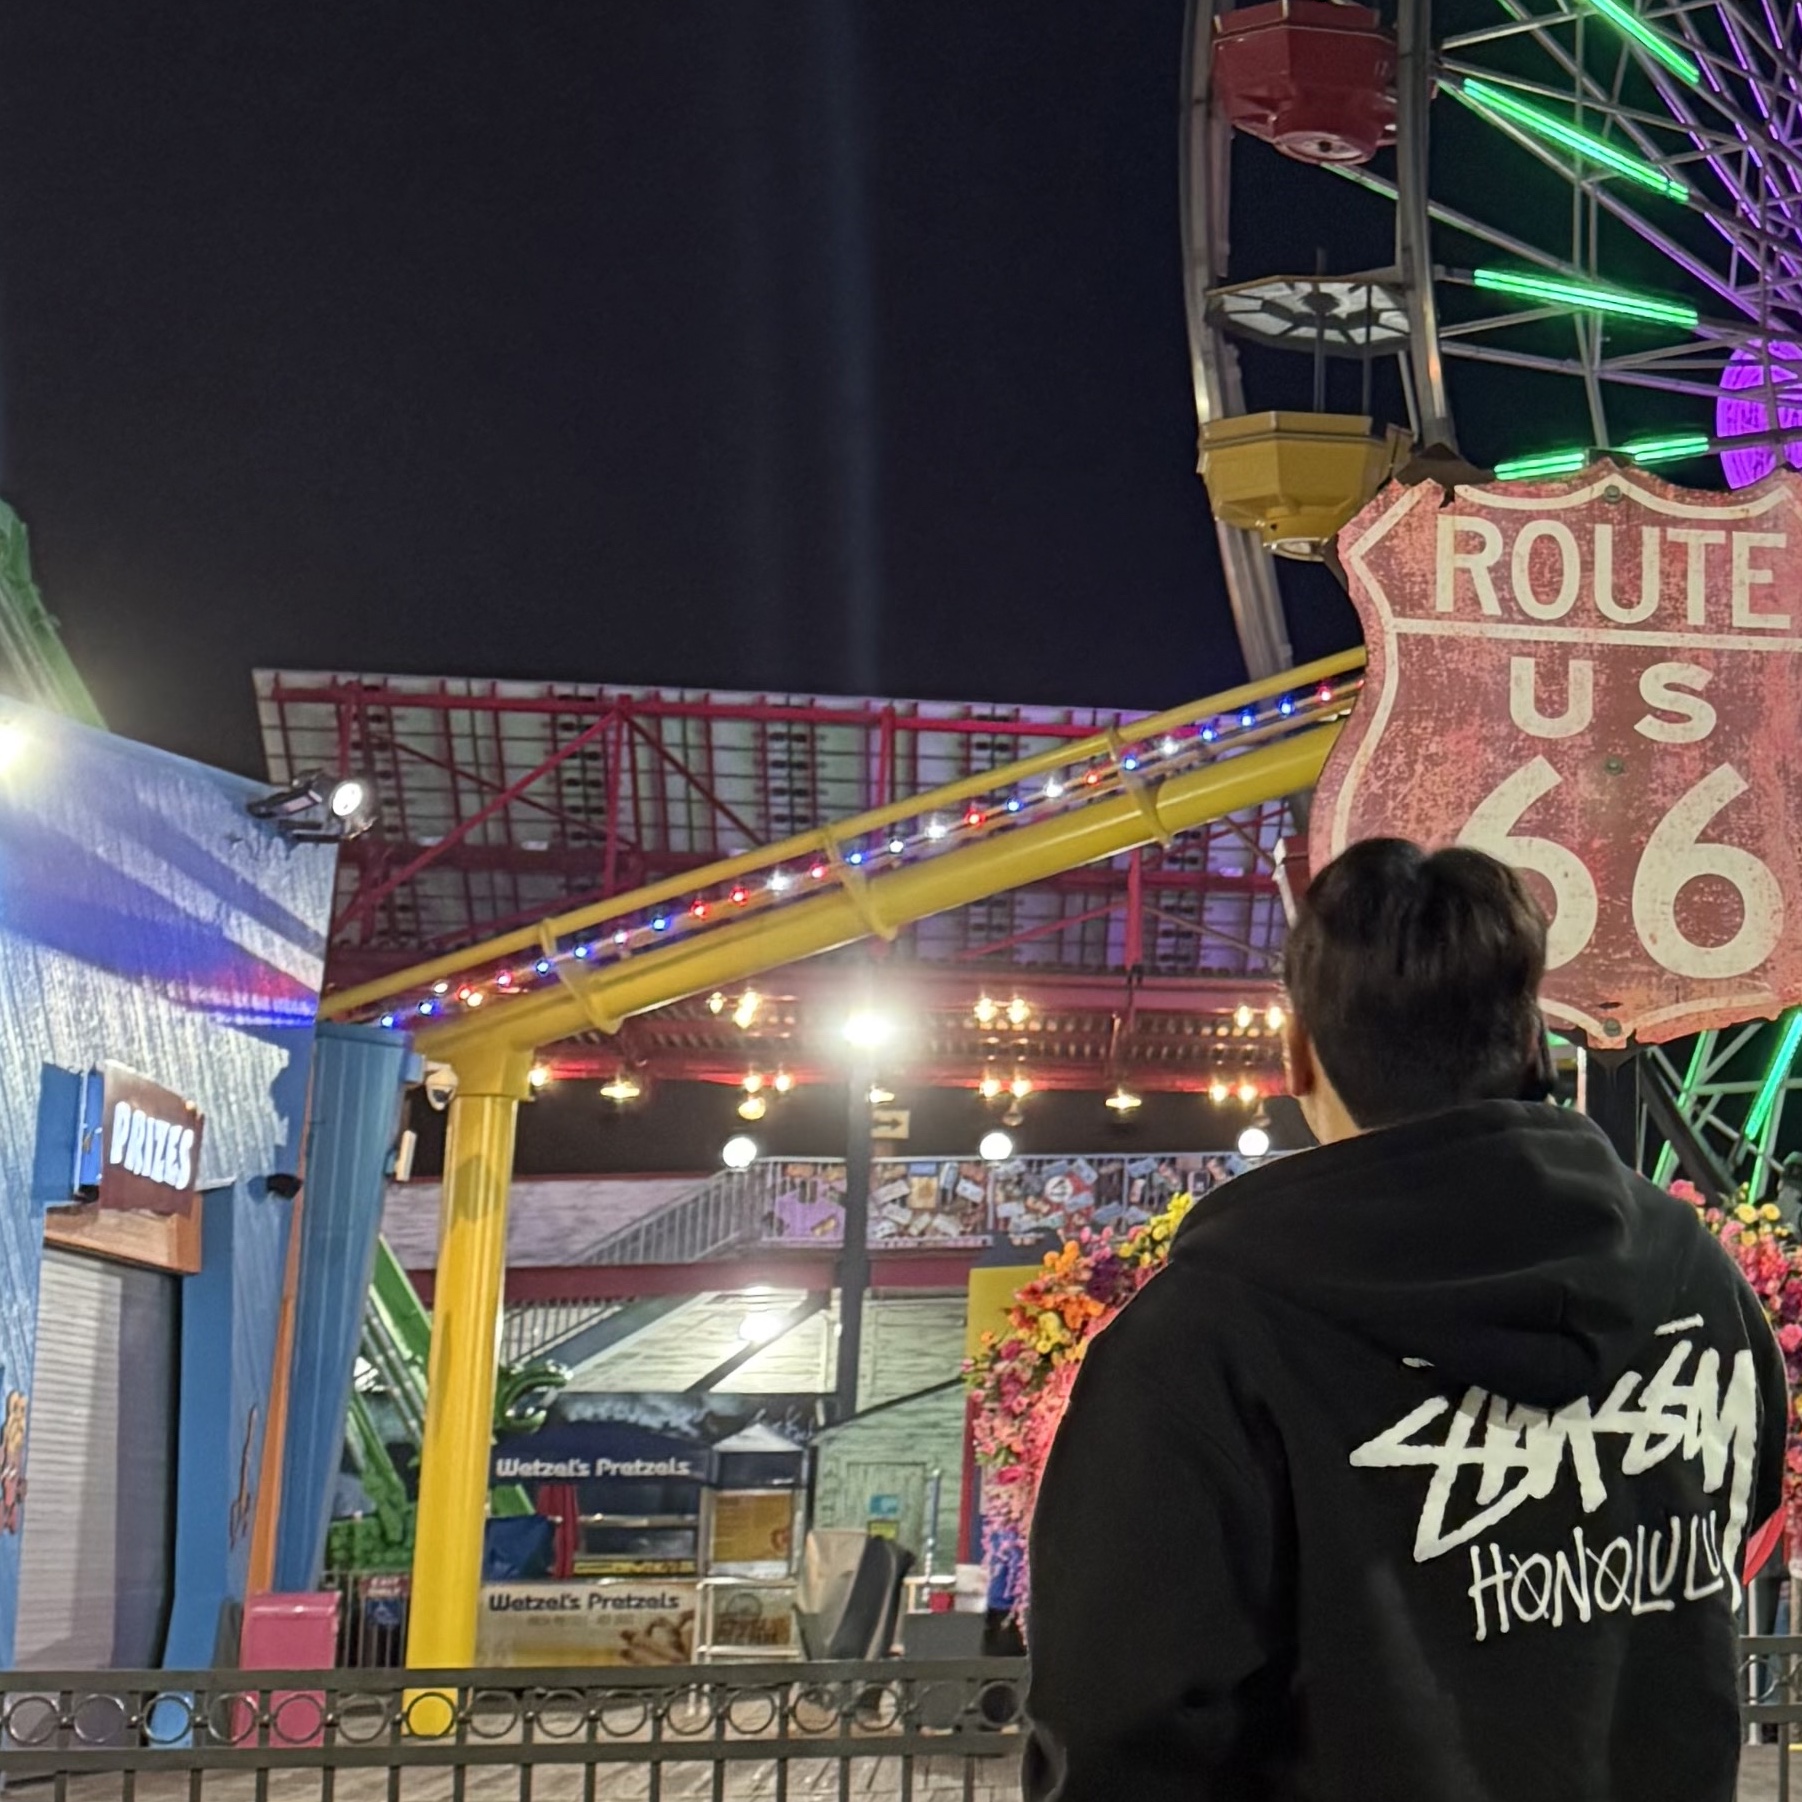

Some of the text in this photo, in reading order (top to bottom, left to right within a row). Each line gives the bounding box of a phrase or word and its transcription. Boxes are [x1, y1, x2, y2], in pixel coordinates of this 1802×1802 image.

[1434, 514, 1792, 630] ROUTE
[110, 1100, 194, 1190] PRIZES
[496, 1457, 690, 1477] Wetzel's Pretzels
[489, 1592, 680, 1611] Wetzel's Pretzels
[1468, 1510, 1724, 1641] HONOLULU
